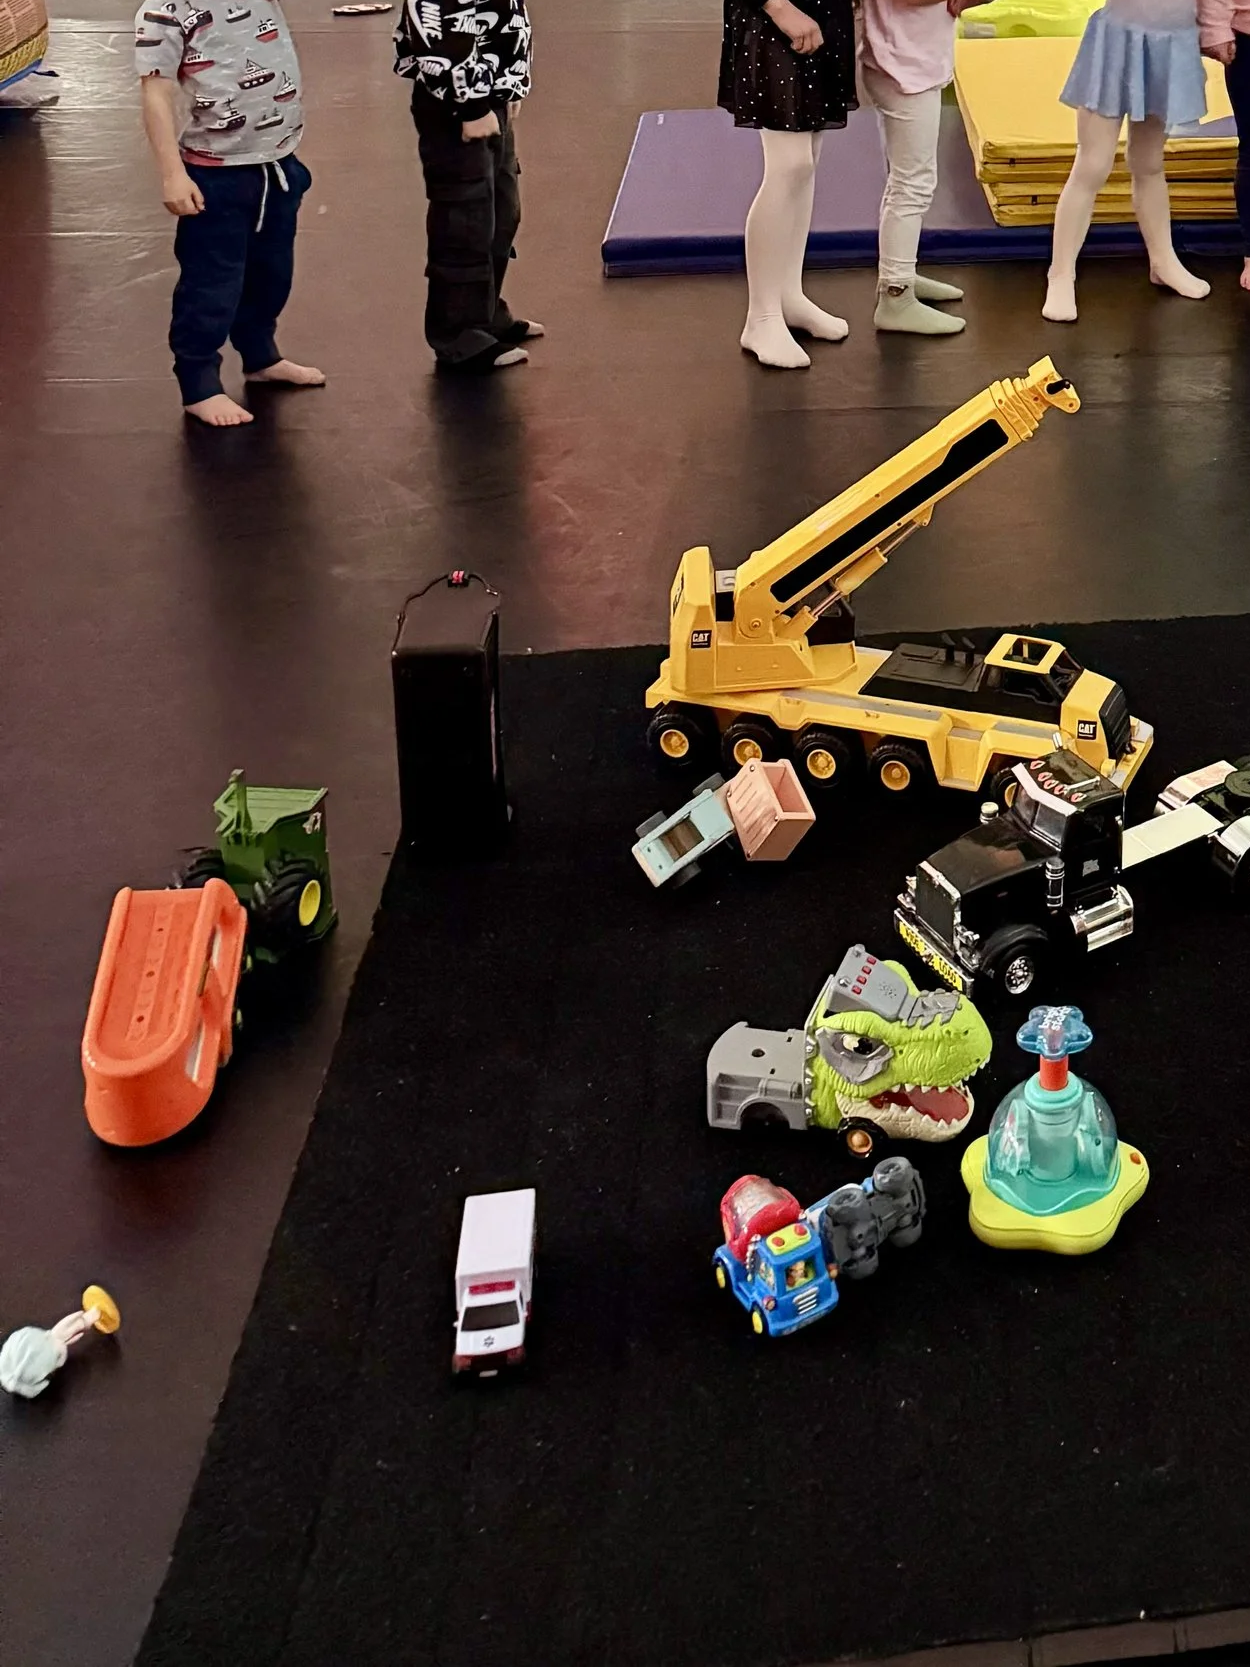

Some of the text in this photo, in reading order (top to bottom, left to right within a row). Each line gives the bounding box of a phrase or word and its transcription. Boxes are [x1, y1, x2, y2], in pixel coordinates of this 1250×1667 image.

[421, 1, 443, 40] NIKE
[692, 633, 710, 643] CAT
[1079, 723, 1096, 734] CAT
